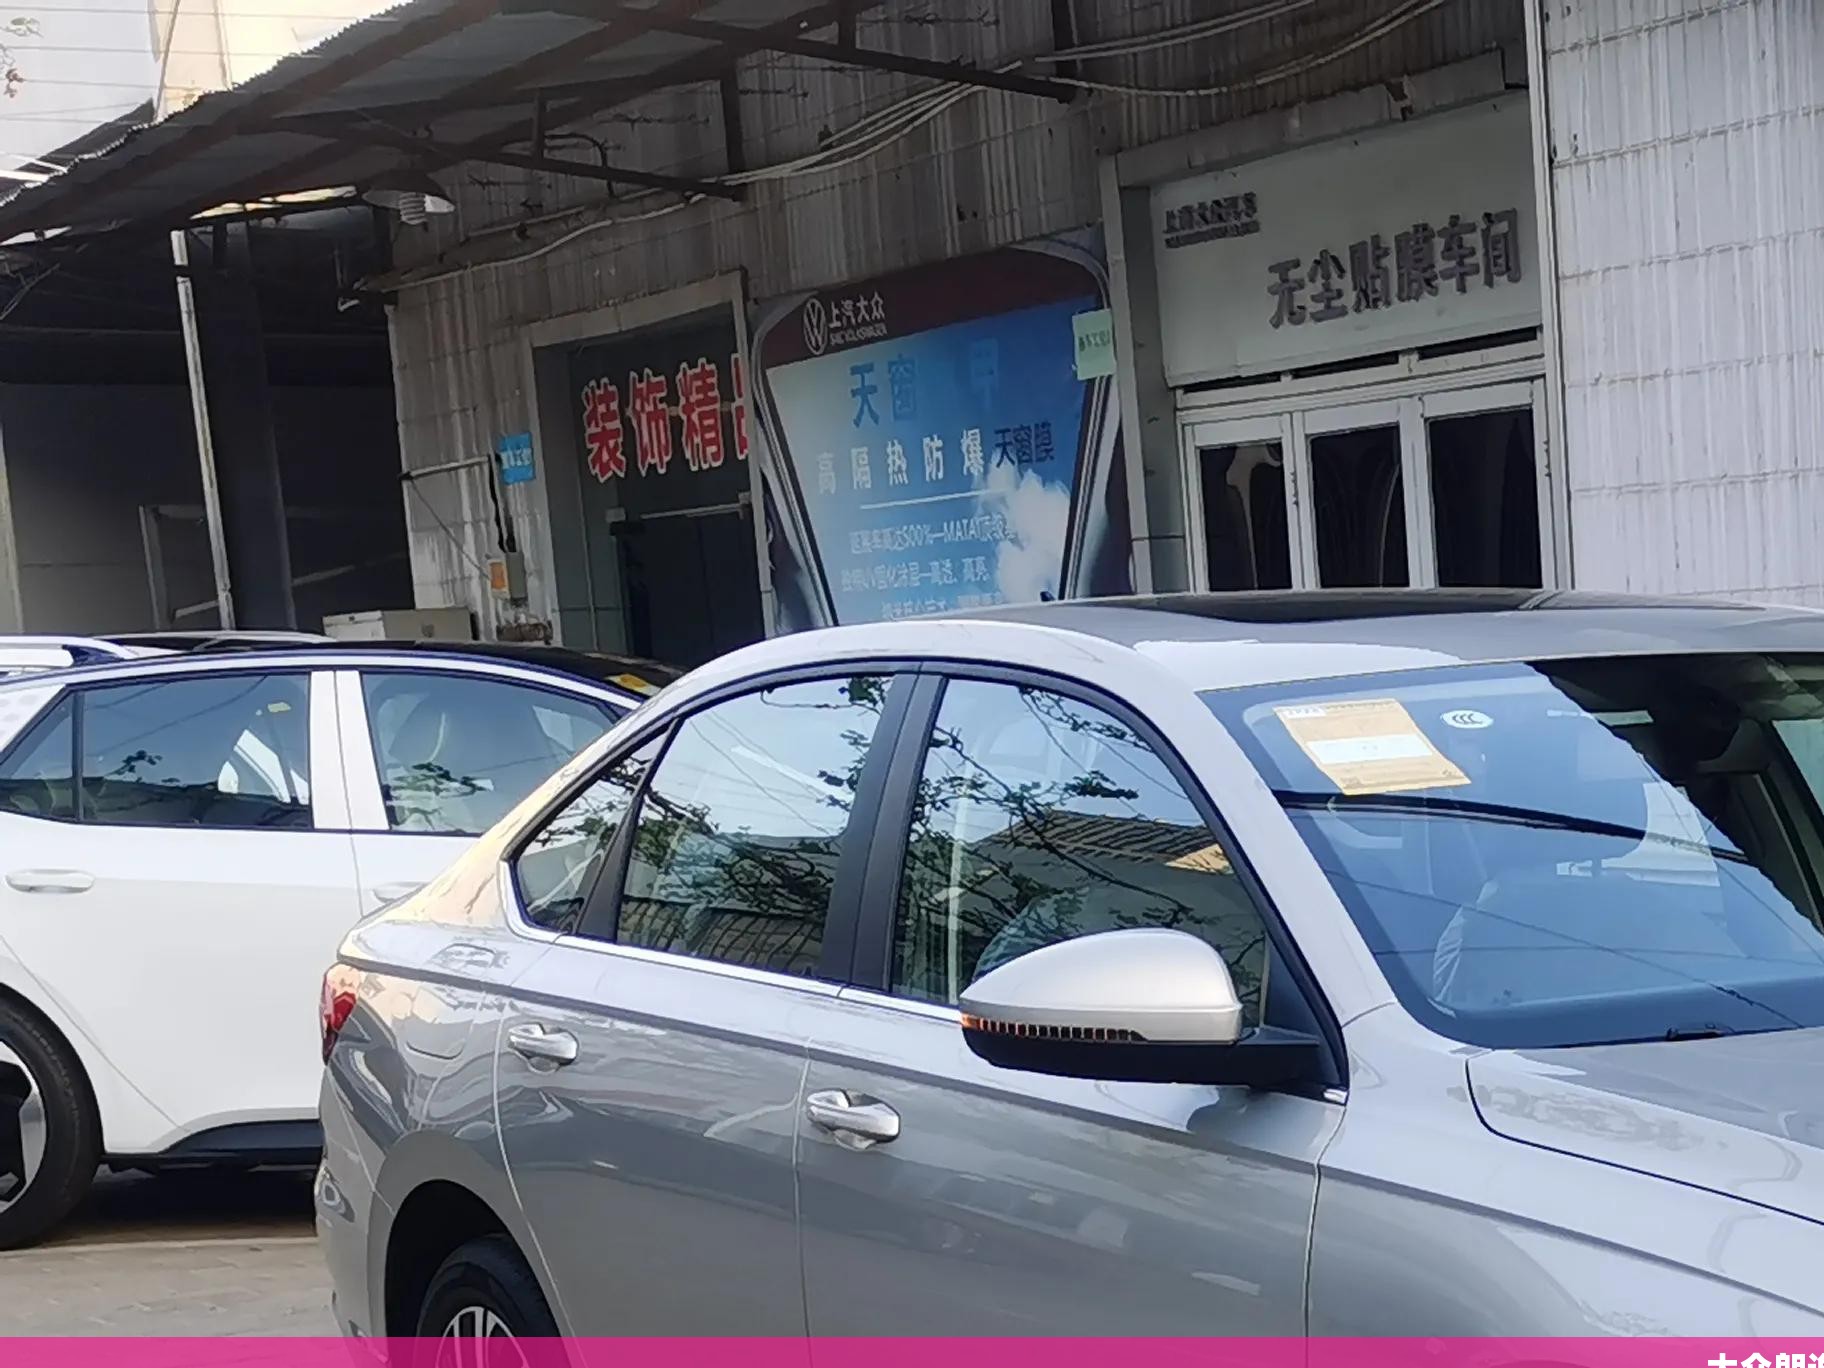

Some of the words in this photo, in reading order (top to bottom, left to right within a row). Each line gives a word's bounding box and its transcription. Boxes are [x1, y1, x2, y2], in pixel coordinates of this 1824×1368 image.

[1269, 208, 1521, 329] 无尘贴膜车间
[828, 291, 886, 329] 上汽大众
[817, 428, 986, 496] 高隔热防爆
